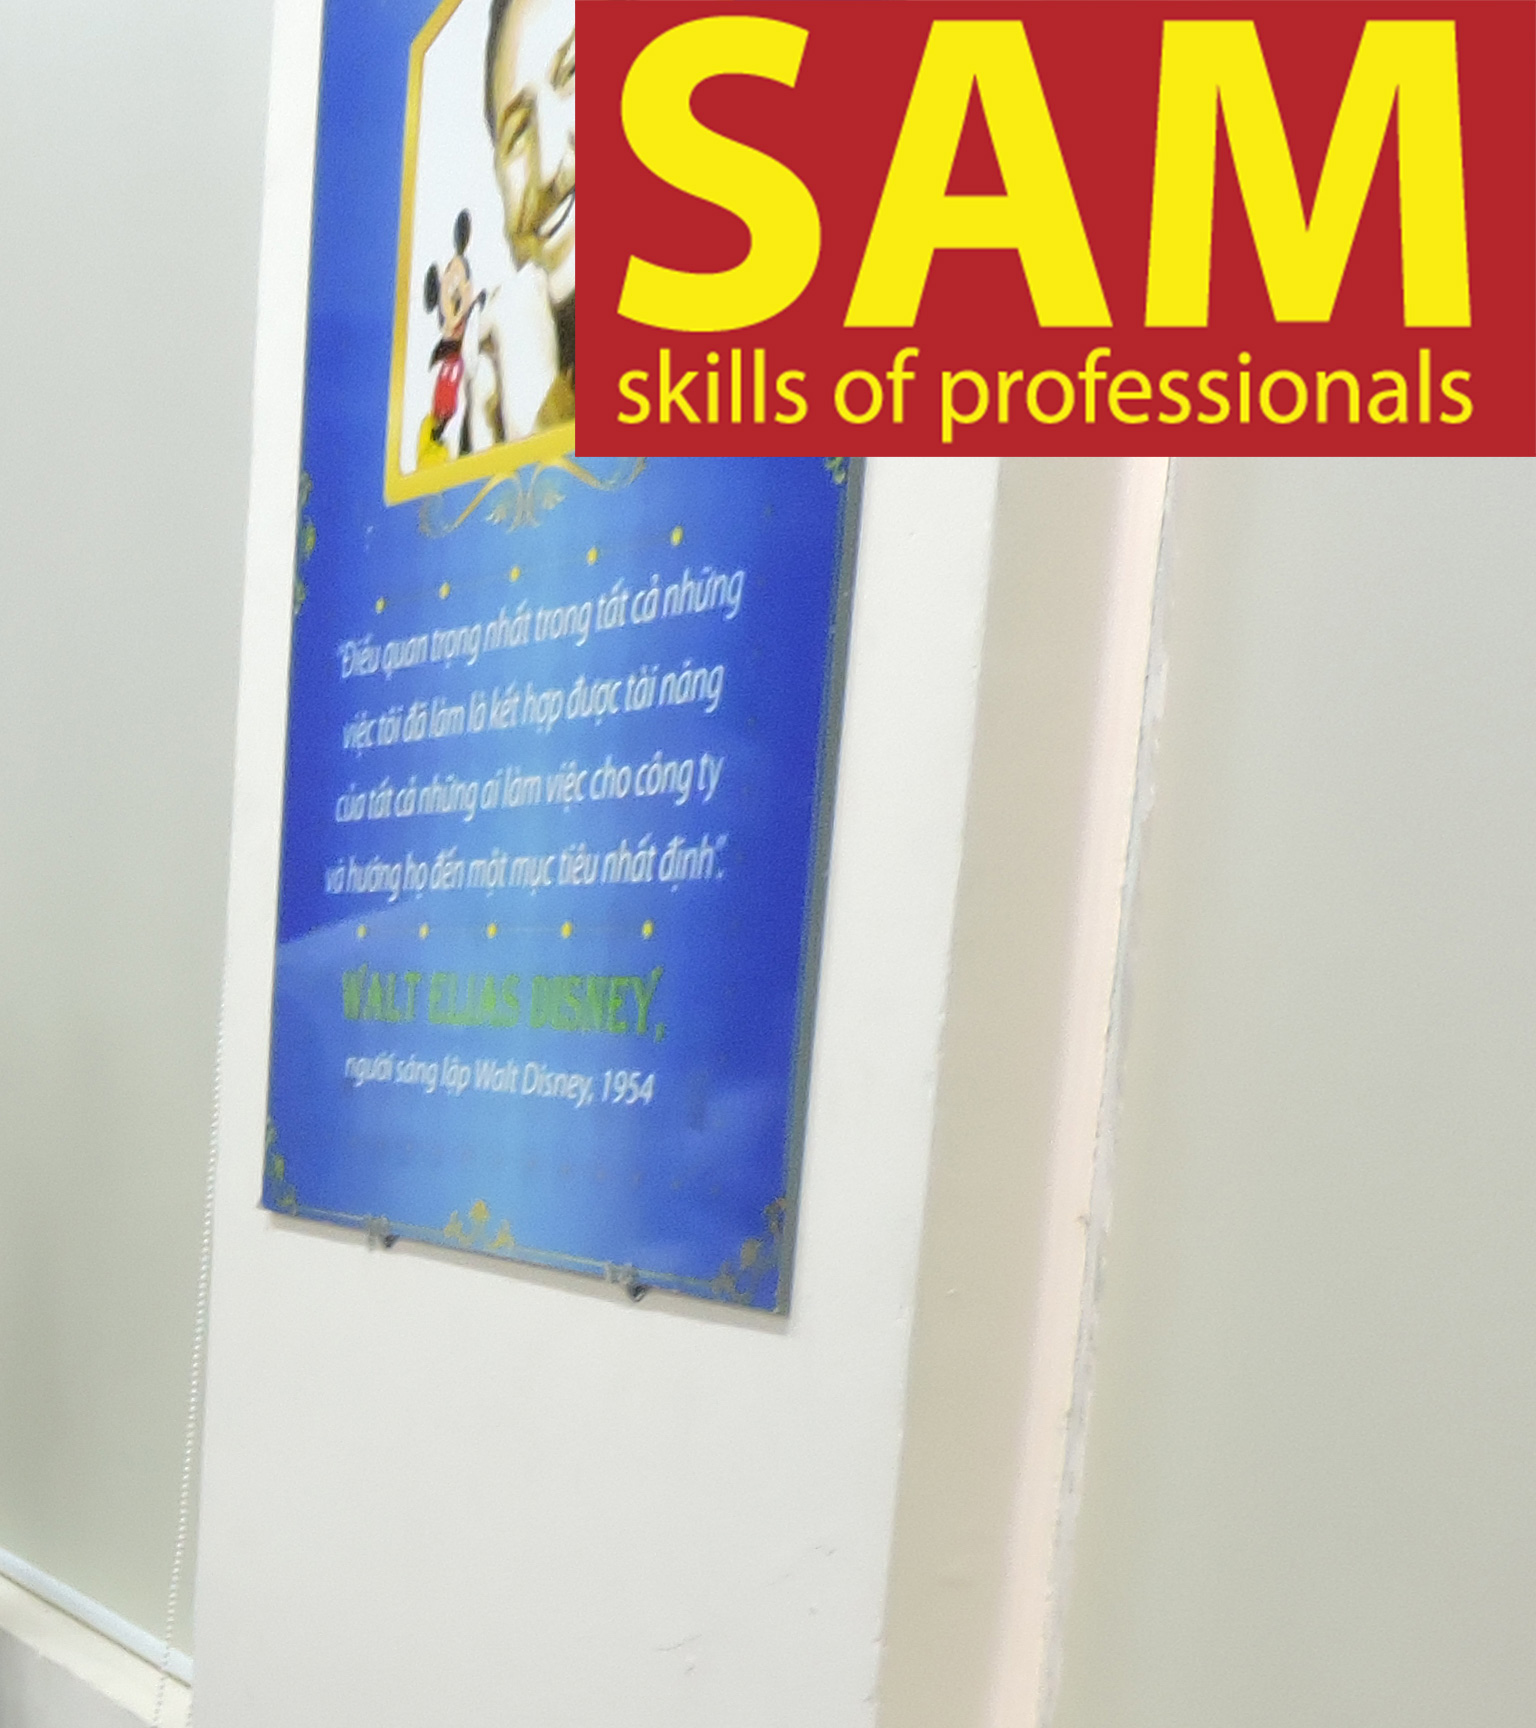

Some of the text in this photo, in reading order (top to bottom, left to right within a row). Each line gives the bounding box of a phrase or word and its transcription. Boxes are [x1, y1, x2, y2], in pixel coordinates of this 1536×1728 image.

[534, 601, 593, 647] trong
[662, 566, 746, 620] những
[545, 759, 588, 814] việc
[589, 753, 632, 801] cho
[635, 750, 694, 807] công
[697, 751, 726, 802] ty
[600, 831, 658, 884] nhất
[342, 961, 423, 1023] WALT
[428, 971, 521, 1028] ELIAS
[475, 1057, 519, 1093] Walt
[601, 1068, 656, 1106] 1954
